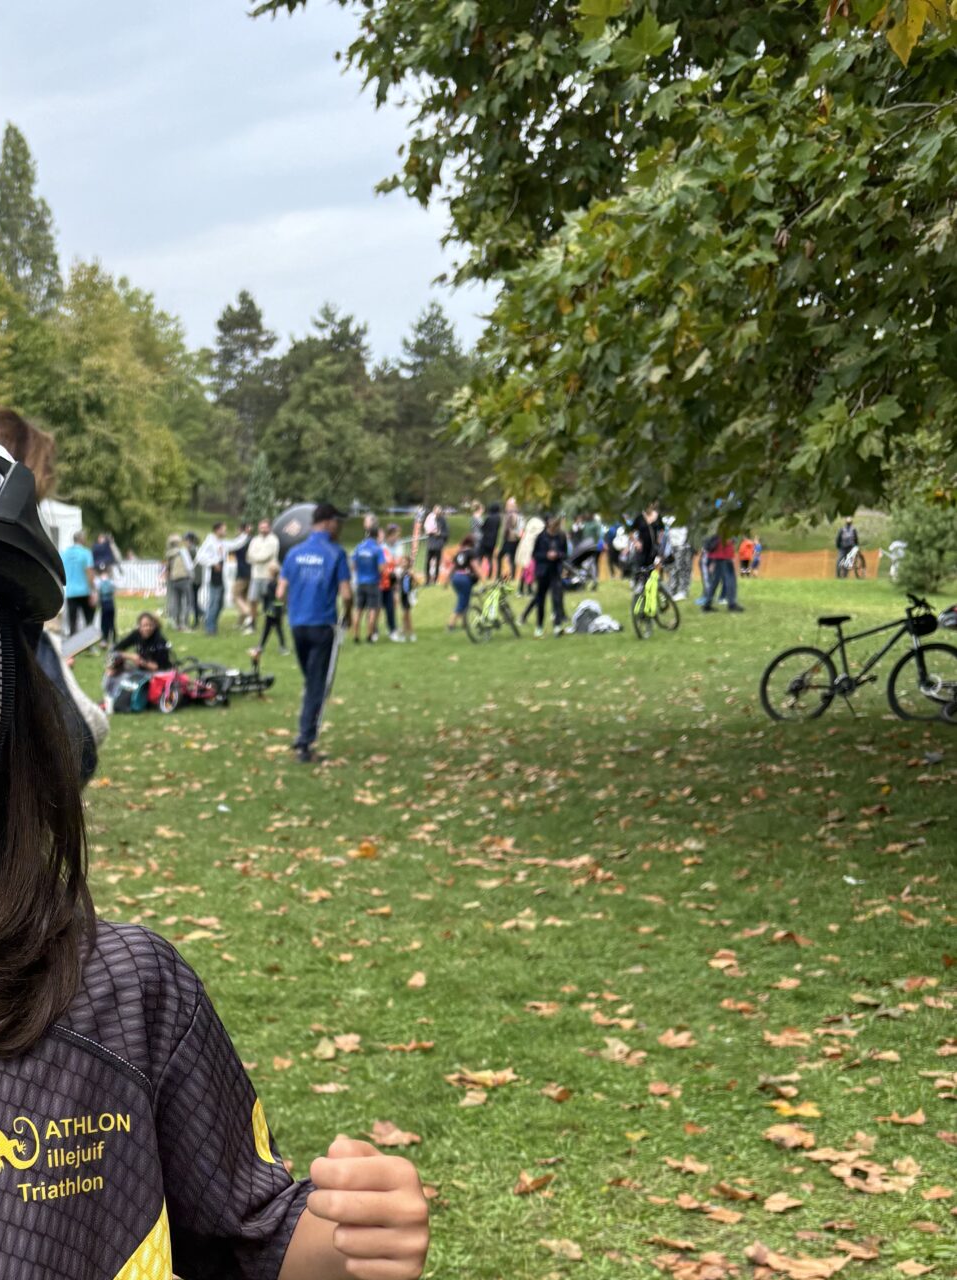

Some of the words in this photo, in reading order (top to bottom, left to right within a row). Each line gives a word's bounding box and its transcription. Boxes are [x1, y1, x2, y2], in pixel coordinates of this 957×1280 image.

[45, 1113, 130, 1139] ATHLON
[47, 1141, 105, 1169] illejuif
[18, 1175, 104, 1202] Triathlon
